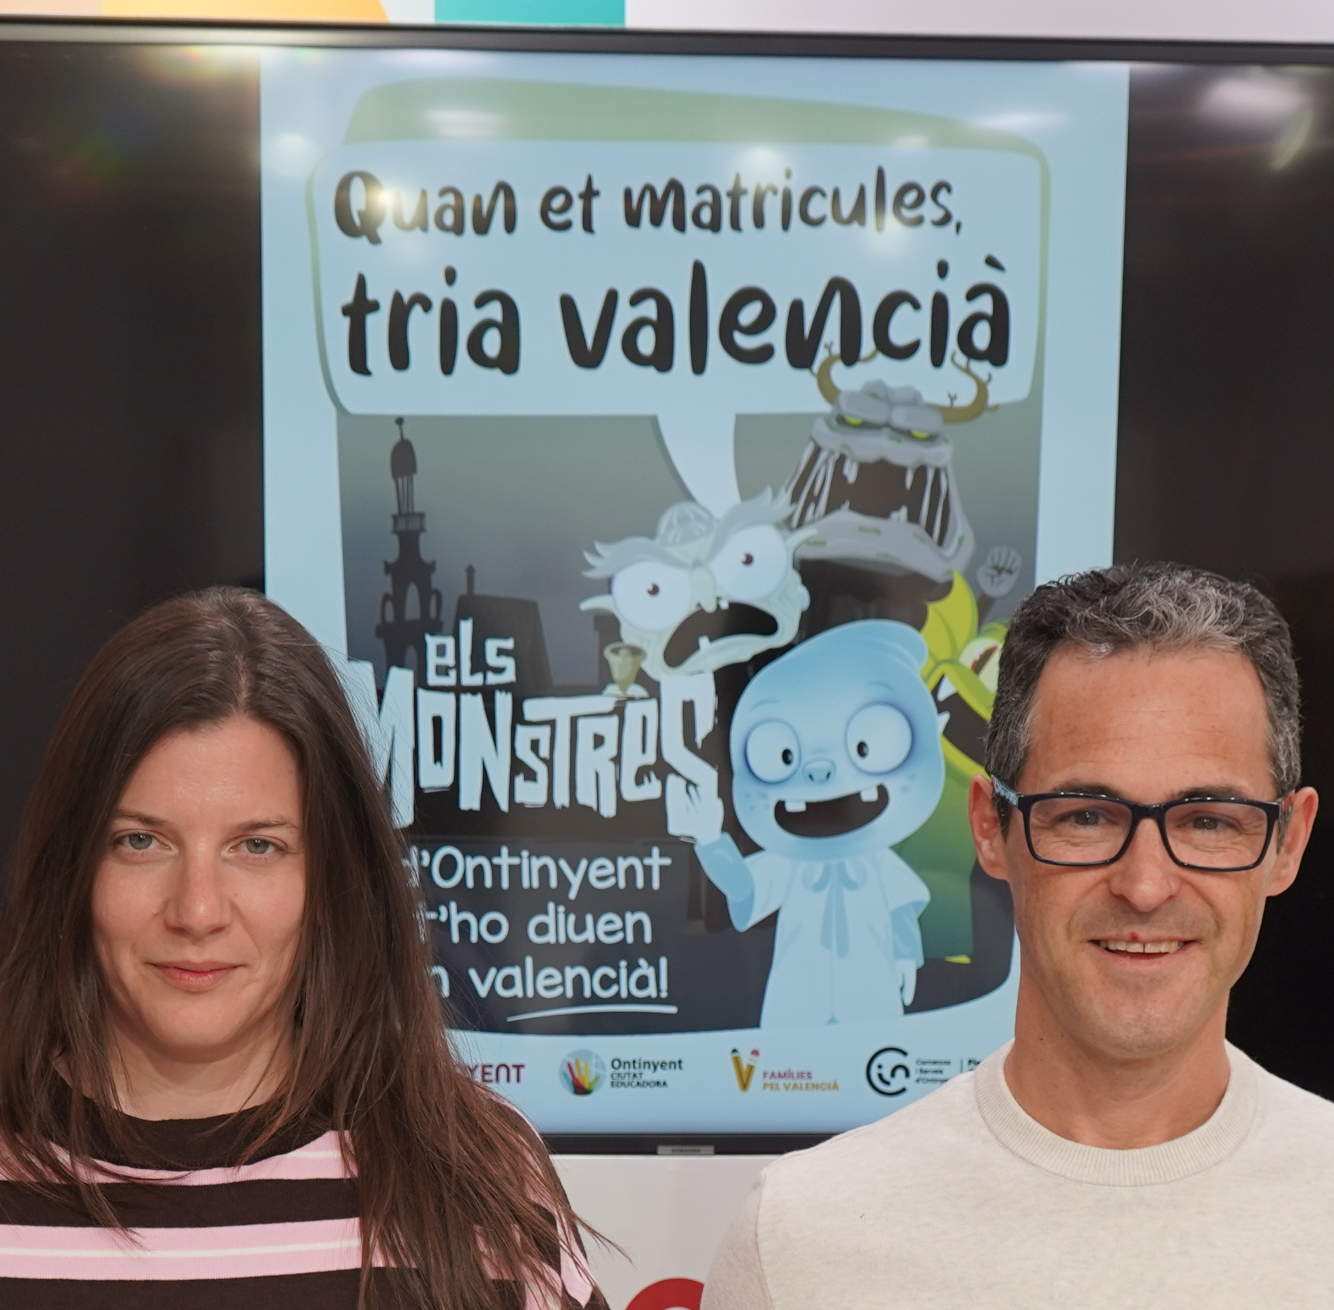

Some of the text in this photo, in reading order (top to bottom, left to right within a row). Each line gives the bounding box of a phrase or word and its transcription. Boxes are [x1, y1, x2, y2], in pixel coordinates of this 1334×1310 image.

[333, 165, 963, 245] Quan et matricules,
[342, 253, 1012, 377] tria valencià
[527, 901, 652, 944] diuen
[468, 955, 668, 999] valencià!
[610, 1057, 684, 1074] Ontinyent
